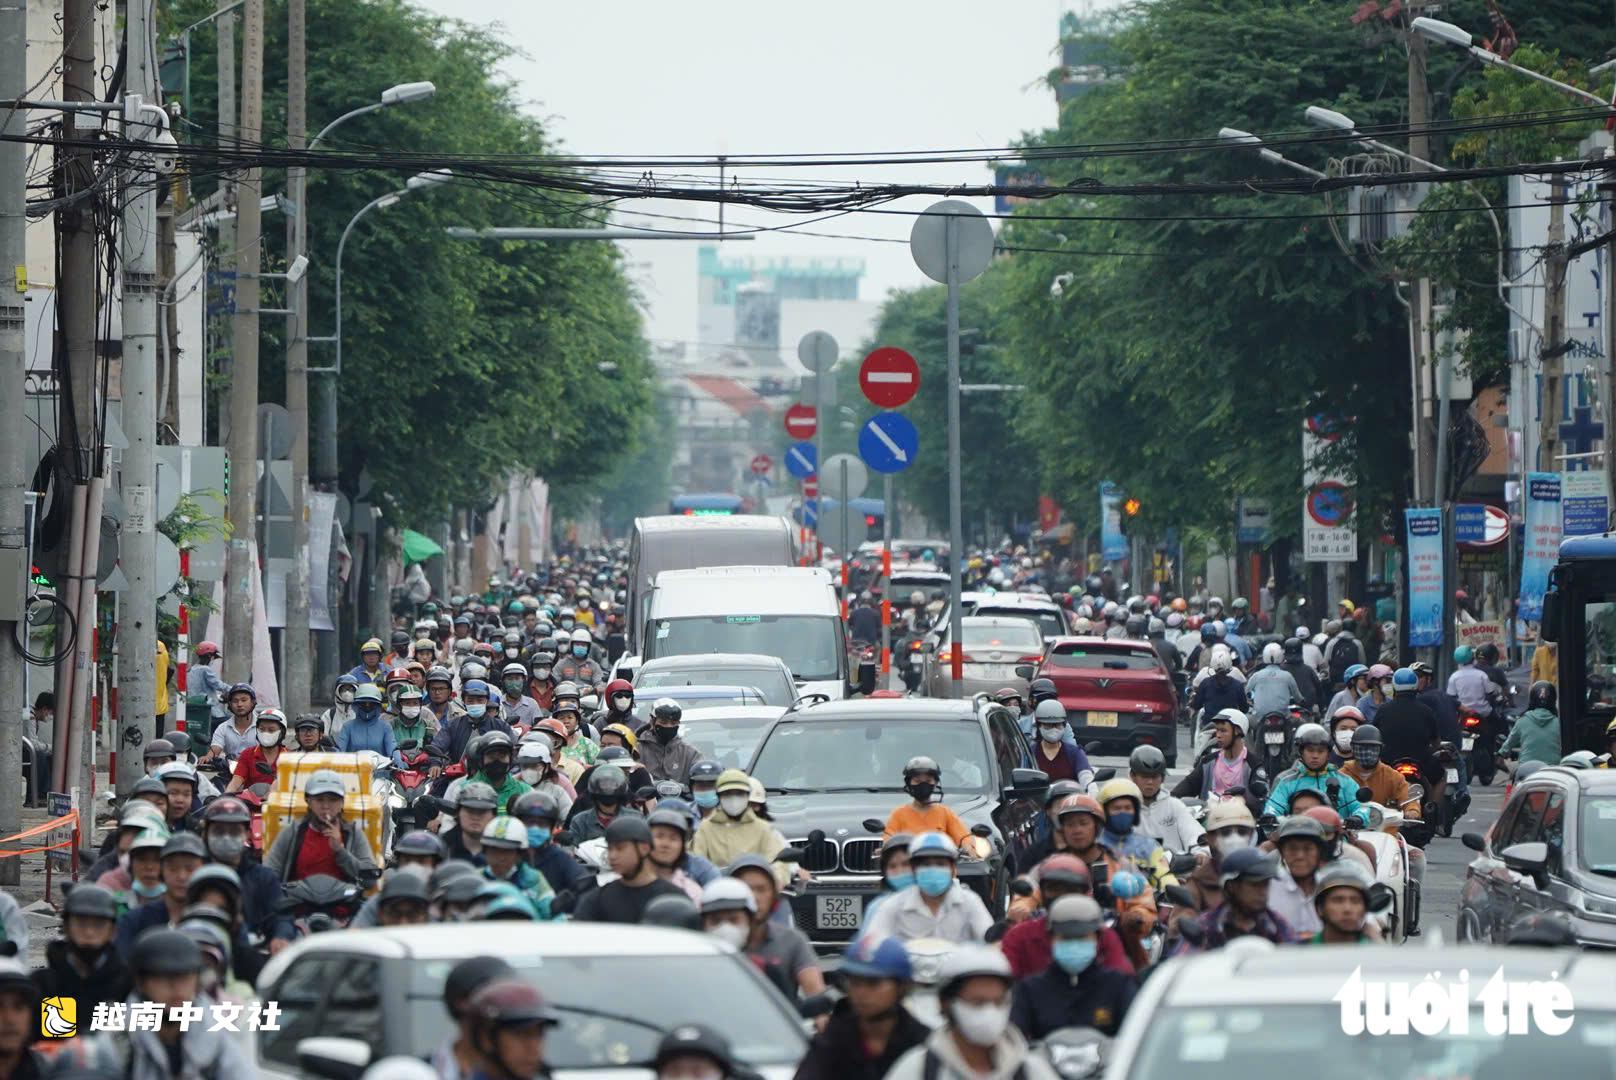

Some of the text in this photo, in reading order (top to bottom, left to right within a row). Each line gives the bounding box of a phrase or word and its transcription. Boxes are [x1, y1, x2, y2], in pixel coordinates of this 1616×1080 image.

[1462, 625, 1500, 637] BISONE
[826, 898, 852, 912] 52P
[822, 912, 857, 927] 5553
